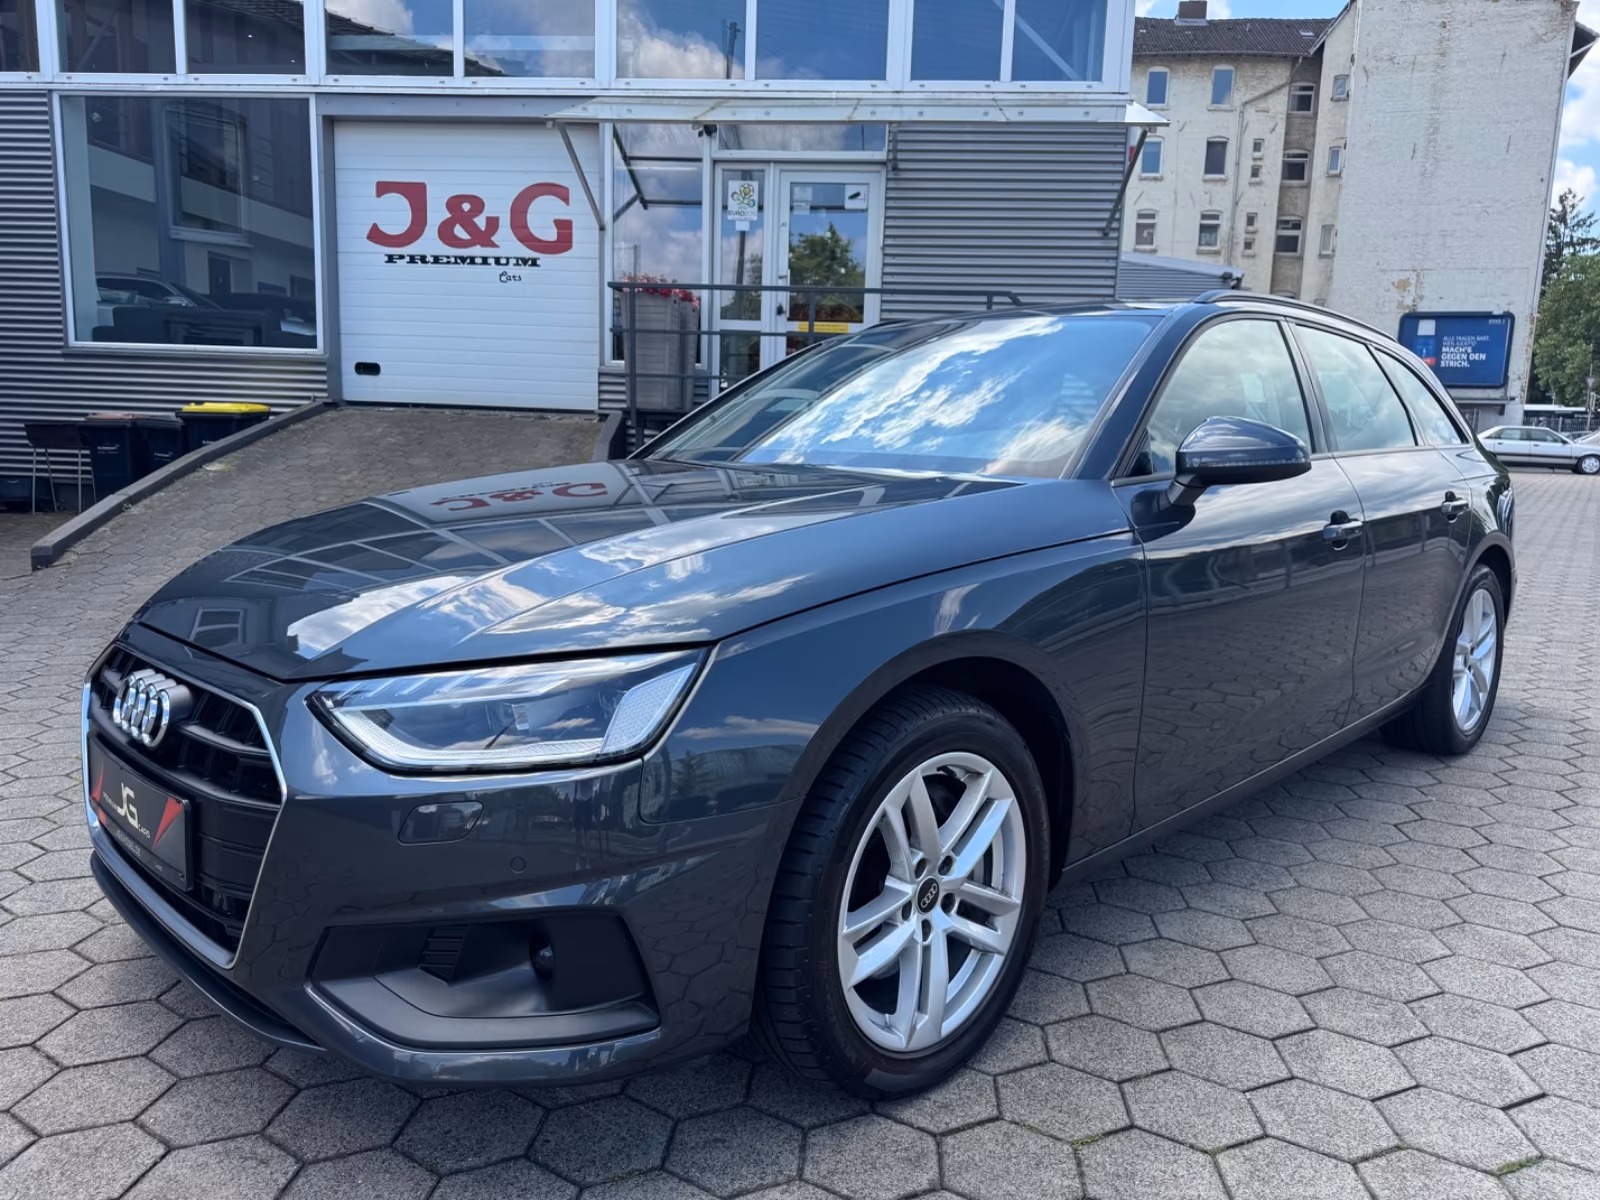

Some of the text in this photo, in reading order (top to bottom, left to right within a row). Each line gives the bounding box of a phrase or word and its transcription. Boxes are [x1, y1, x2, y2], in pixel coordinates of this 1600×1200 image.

[366, 181, 573, 255] J&G
[384, 253, 541, 267] PREMIUM
[499, 271, 522, 283] Cars
[1440, 360, 1470, 368] STRICH.
[117, 782, 139, 829] JG
